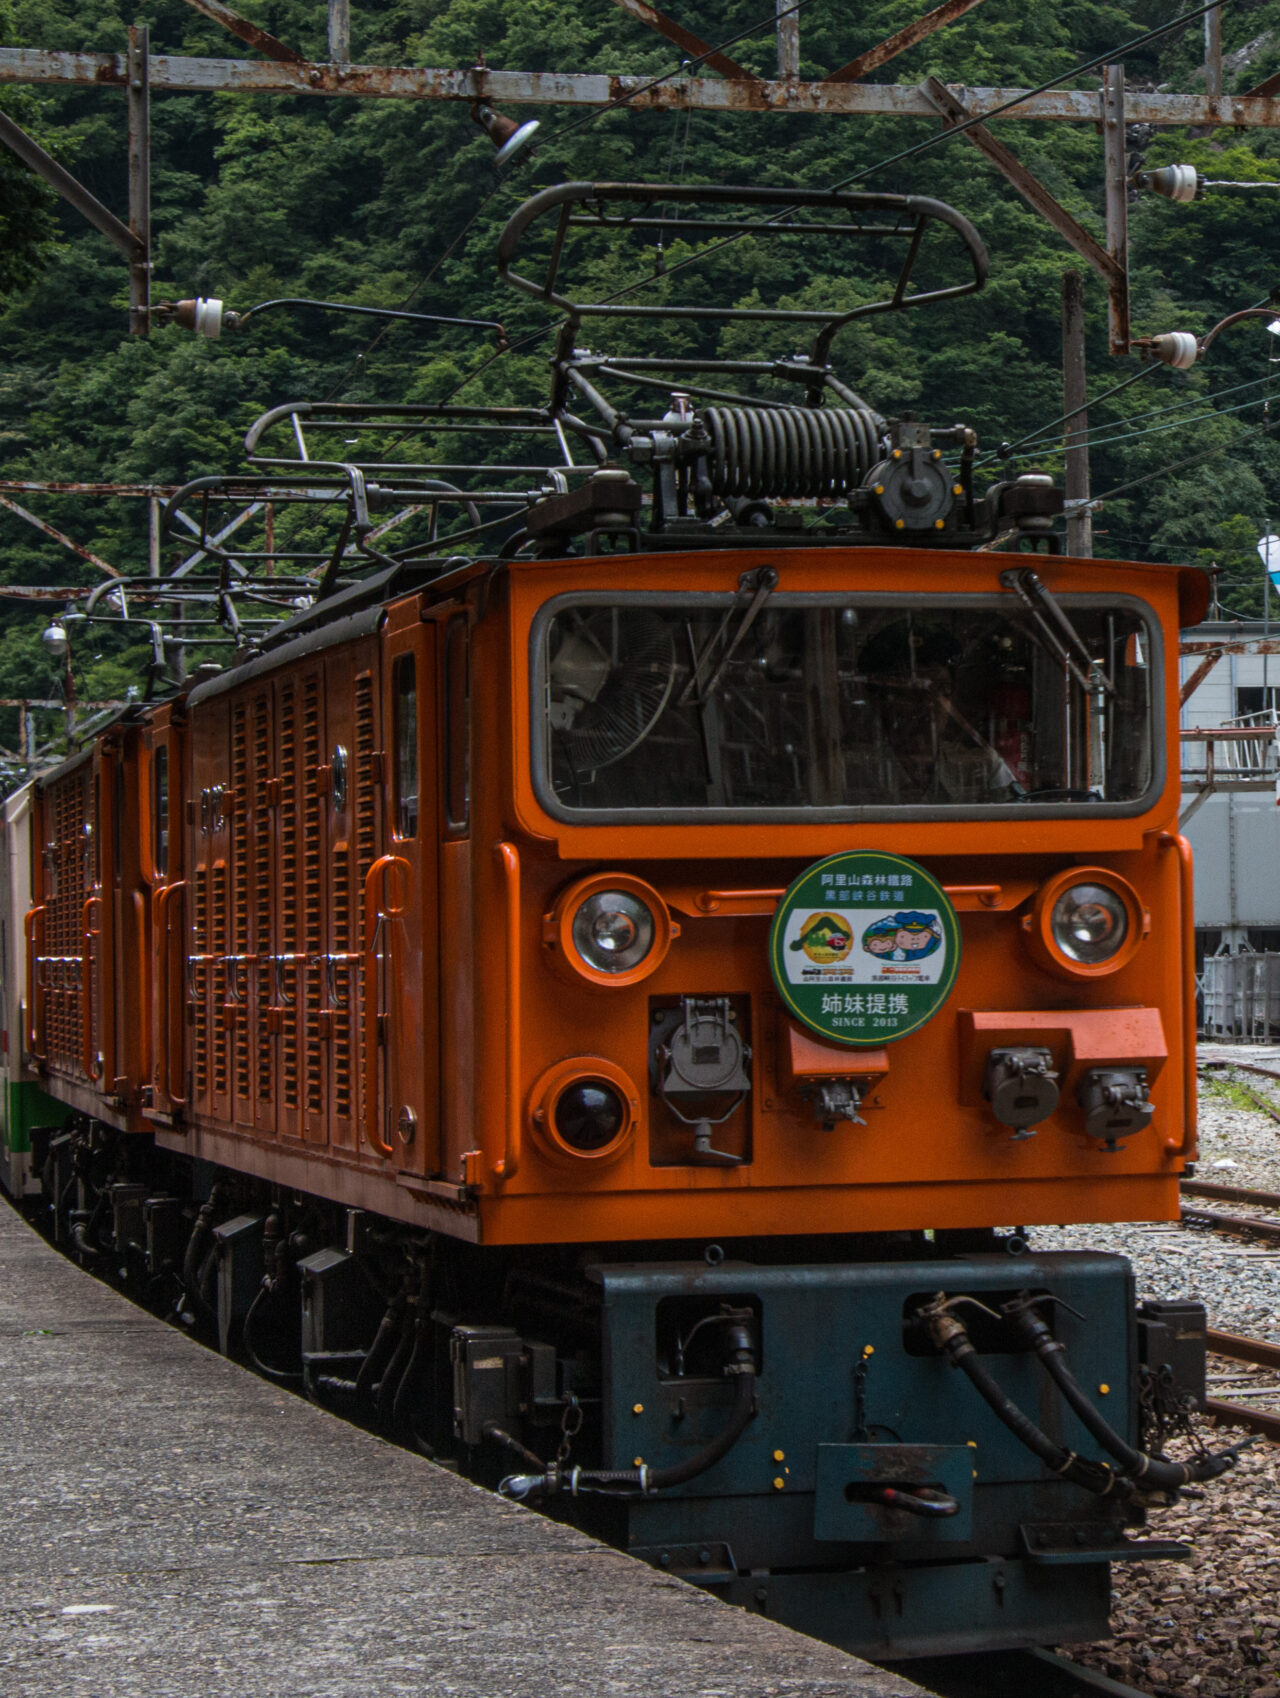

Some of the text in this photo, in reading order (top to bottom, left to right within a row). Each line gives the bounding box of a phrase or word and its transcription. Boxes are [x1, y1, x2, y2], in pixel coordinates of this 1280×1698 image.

[821, 874, 913, 887] 阿里山森林鐵路
[821, 993, 909, 1015] 姉妹提携
[832, 1017, 898, 1027] SINCE 2013
